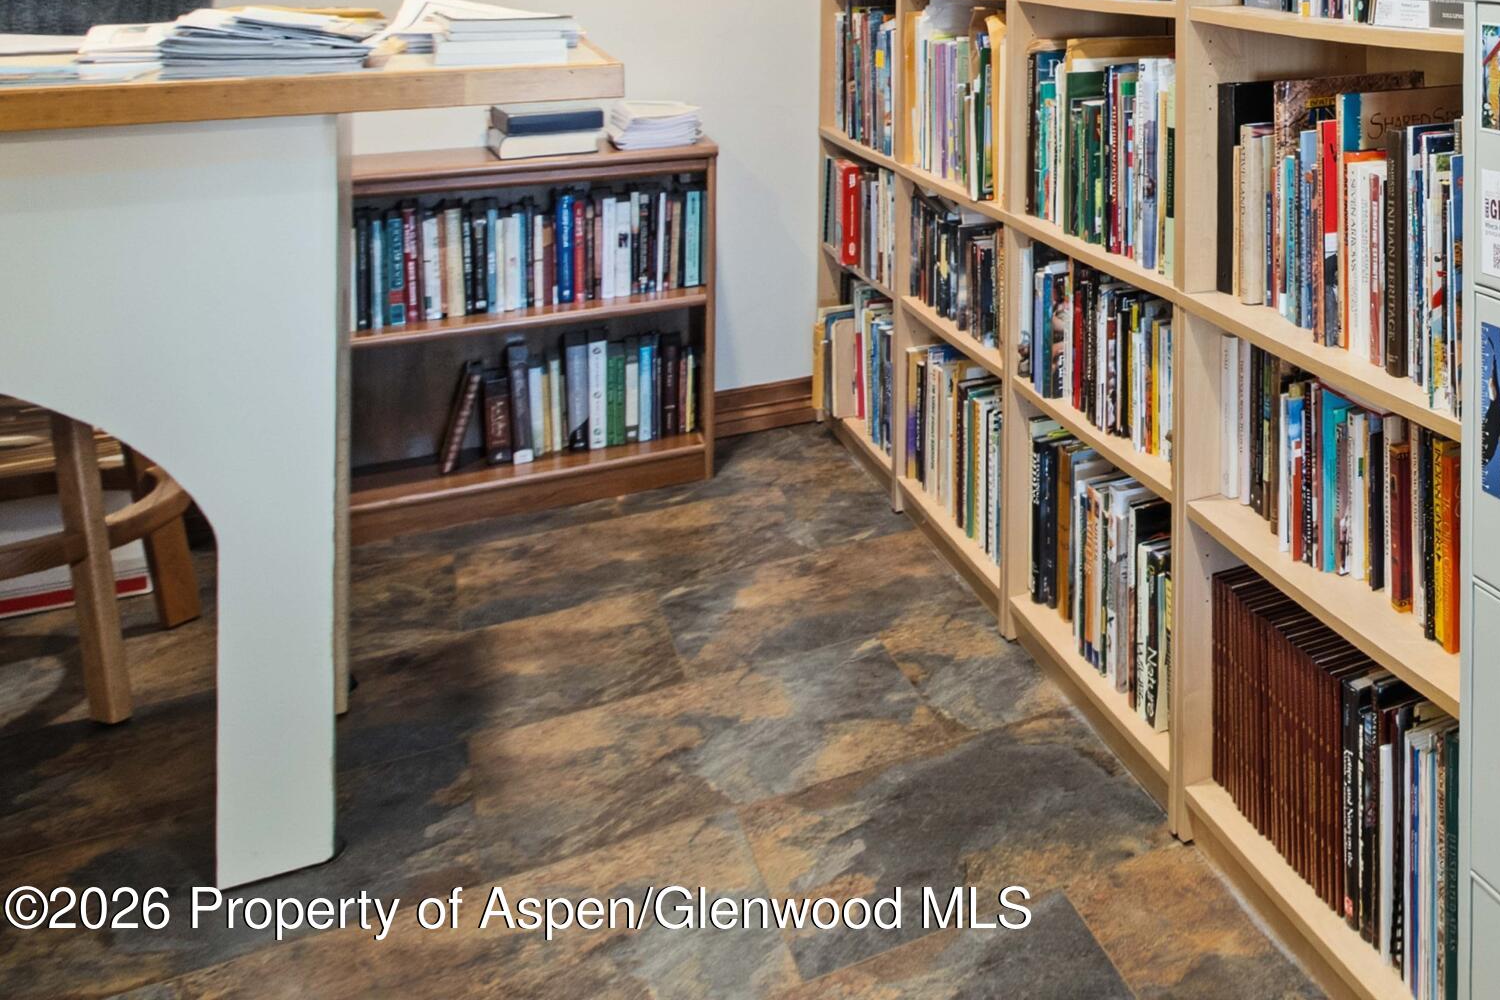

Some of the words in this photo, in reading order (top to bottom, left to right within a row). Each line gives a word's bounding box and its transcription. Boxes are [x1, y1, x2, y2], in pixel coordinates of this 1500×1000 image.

[1388, 261, 1396, 341] HERITAGE
[1434, 447, 1442, 499] INDIAN
[1146, 646, 1158, 718] Nature
